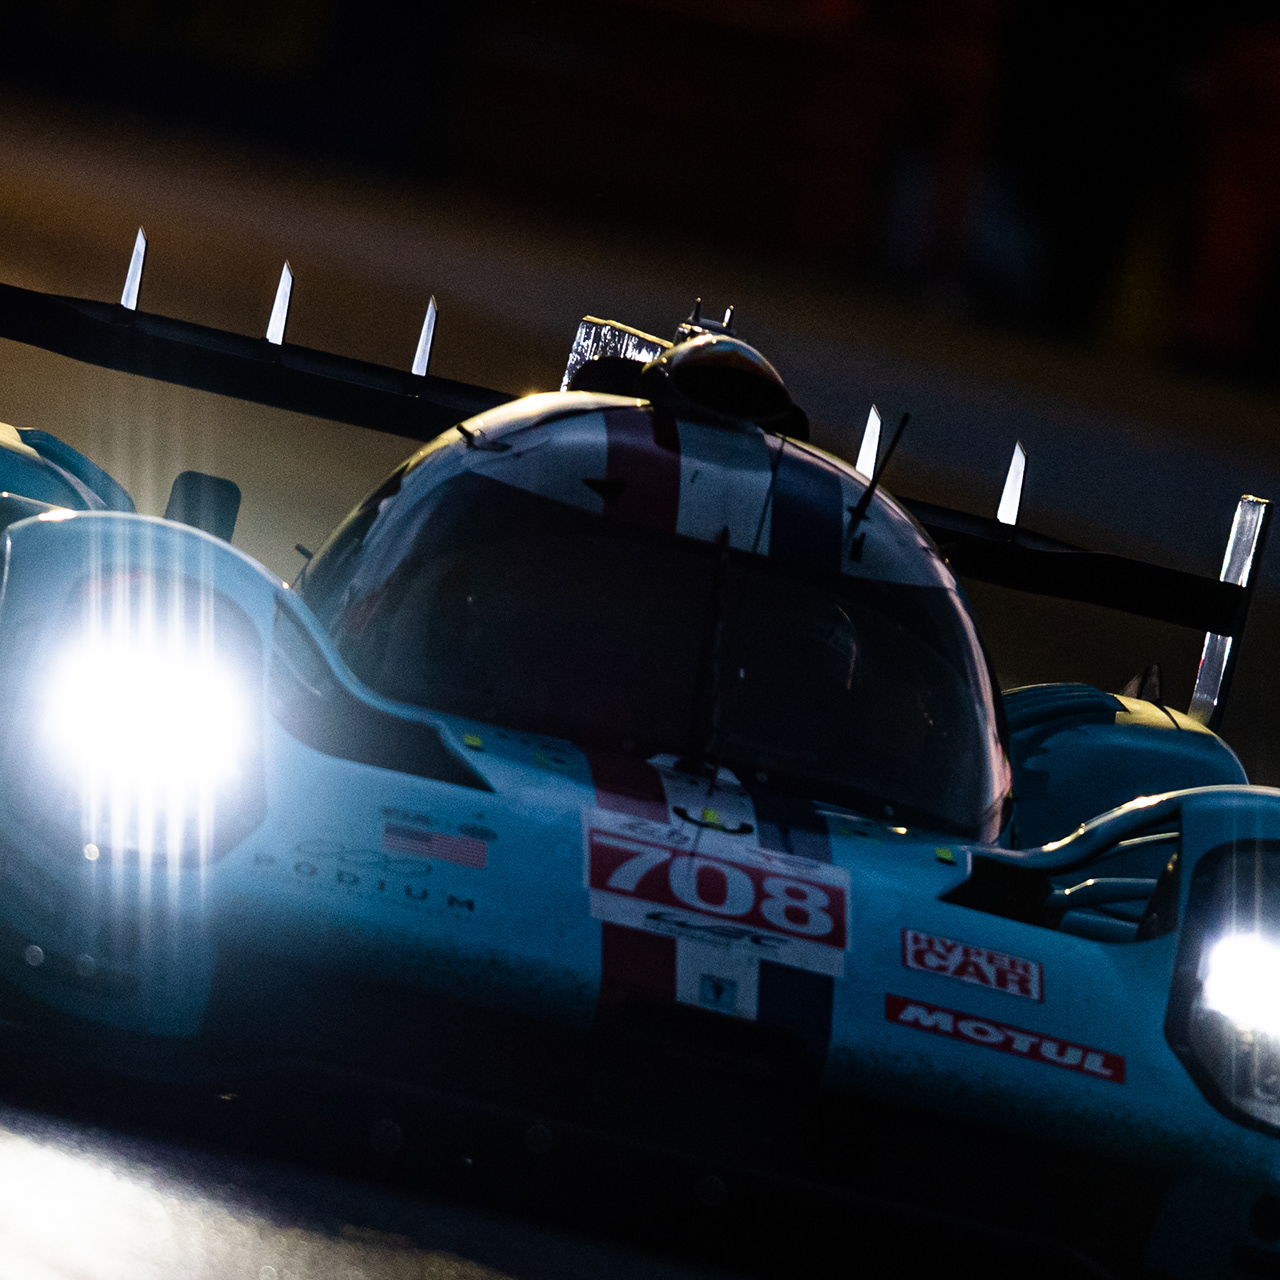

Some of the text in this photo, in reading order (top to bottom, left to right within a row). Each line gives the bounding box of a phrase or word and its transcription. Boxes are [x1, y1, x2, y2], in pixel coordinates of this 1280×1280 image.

[591, 832, 834, 937] 708
[912, 932, 1031, 975] HYPER
[912, 948, 1031, 997] CAR
[897, 1003, 1115, 1077] MOTUL
